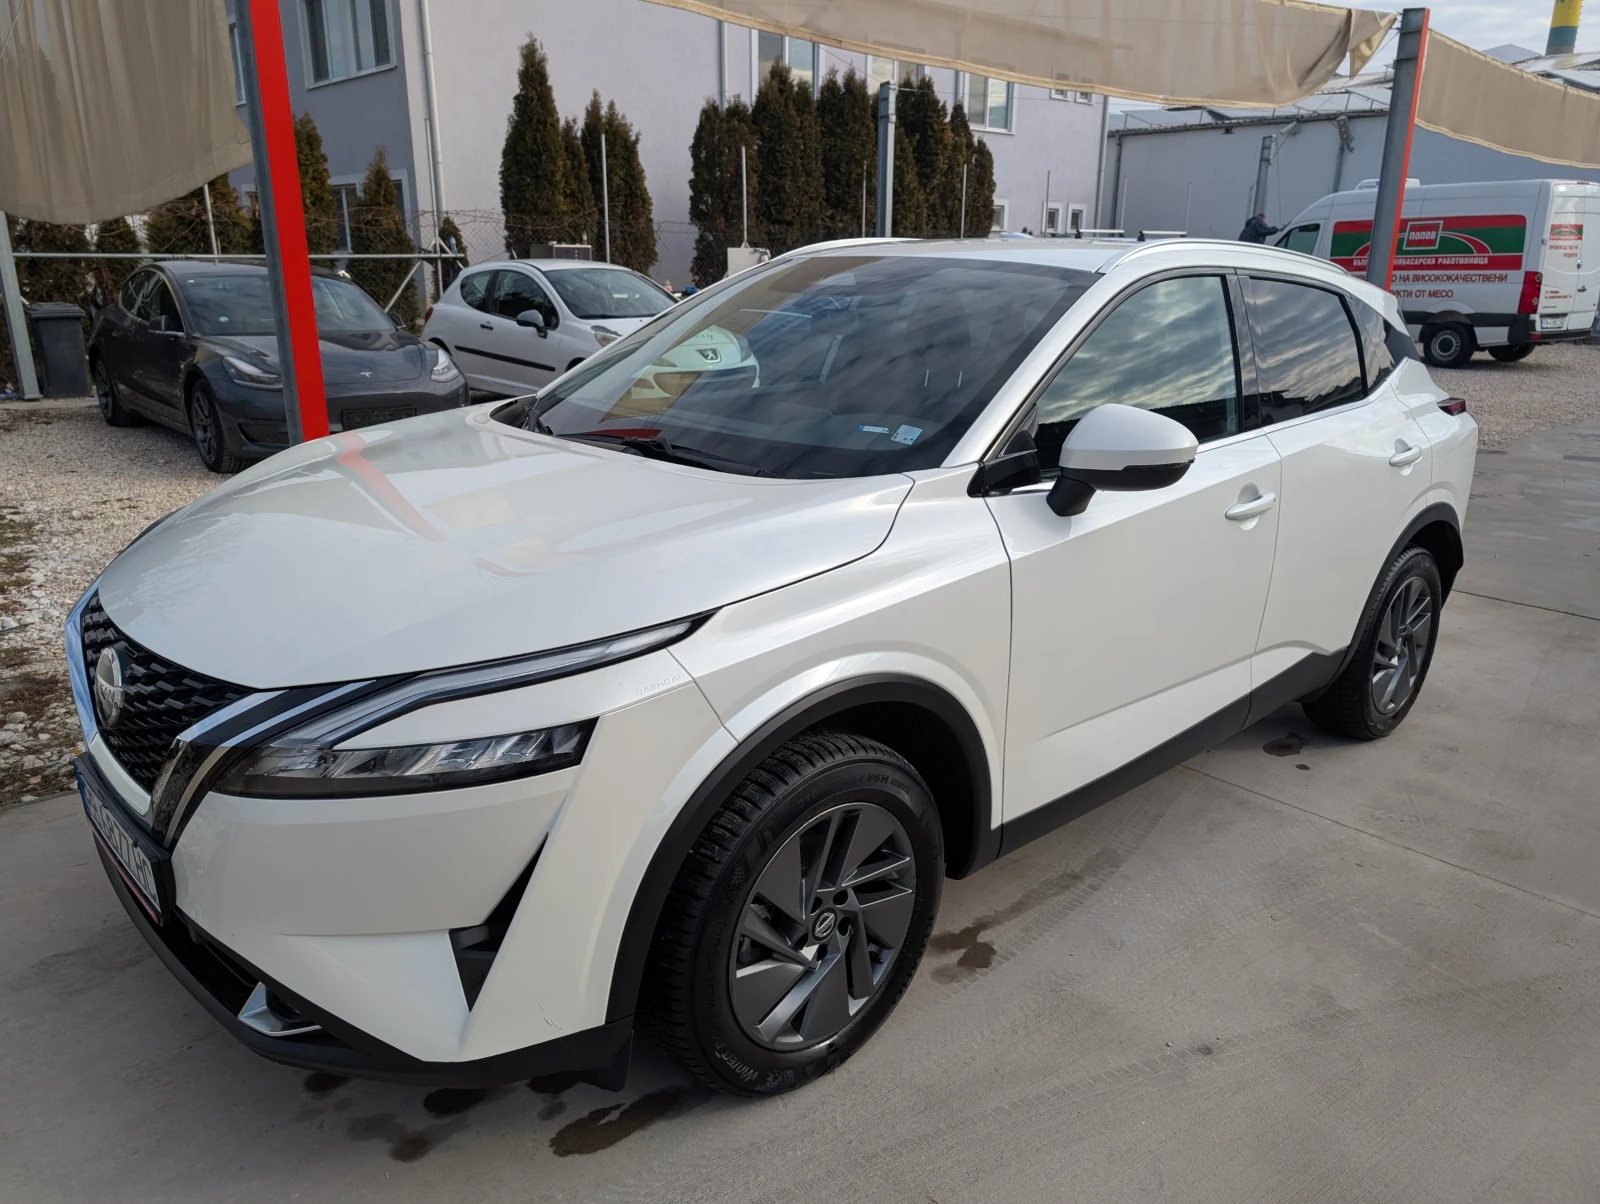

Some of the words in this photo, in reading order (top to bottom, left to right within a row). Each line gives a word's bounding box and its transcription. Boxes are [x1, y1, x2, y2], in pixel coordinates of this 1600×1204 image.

[1408, 230, 1436, 241] ПОПОВ
[1394, 257, 1436, 266] ОЛБАСАРСКА
[1437, 256, 1489, 266] РАБОТИЛНИЦА
[1399, 274, 1410, 283] НА
[1412, 273, 1508, 283] ВИСОКОКАЧЕСТВЕНИ
[1414, 289, 1427, 299] ОТ
[1428, 289, 1454, 299] МЕСО
[635, 674, 681, 696] QASHQAI
[866, 772, 890, 785] 96H
